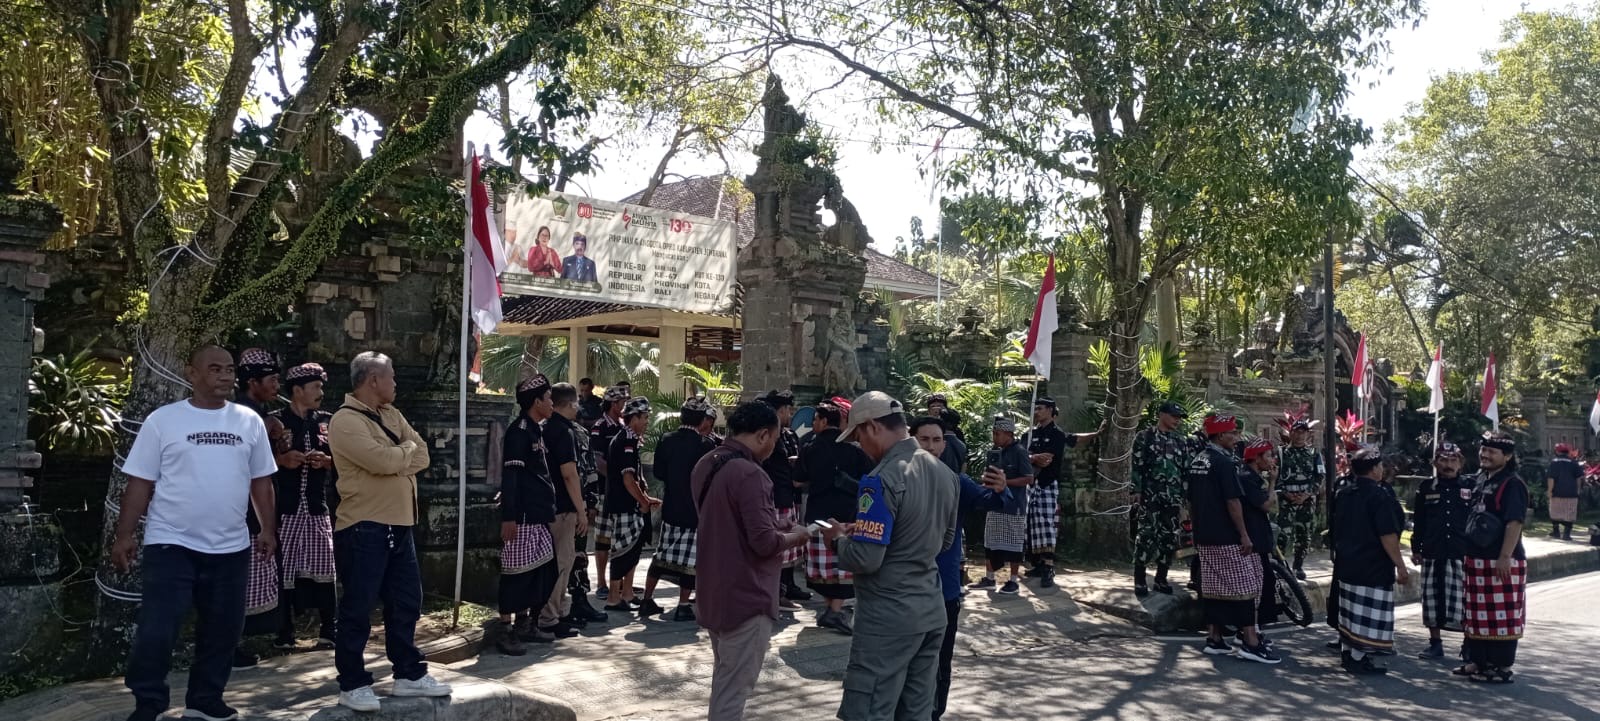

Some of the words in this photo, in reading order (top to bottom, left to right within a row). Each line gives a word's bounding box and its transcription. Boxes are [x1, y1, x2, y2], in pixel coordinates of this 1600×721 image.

[608, 259, 622, 269] HUT
[623, 261, 646, 272] KE-80
[608, 270, 643, 282] REPUBLIK
[654, 271, 678, 280] KE-67
[694, 271, 705, 279] HUT
[608, 281, 646, 293] INDONESIA
[654, 279, 690, 290] PROVINSI
[694, 281, 711, 290] KOTA
[654, 288, 672, 296] BALI
[694, 291, 720, 301] NEGARA
